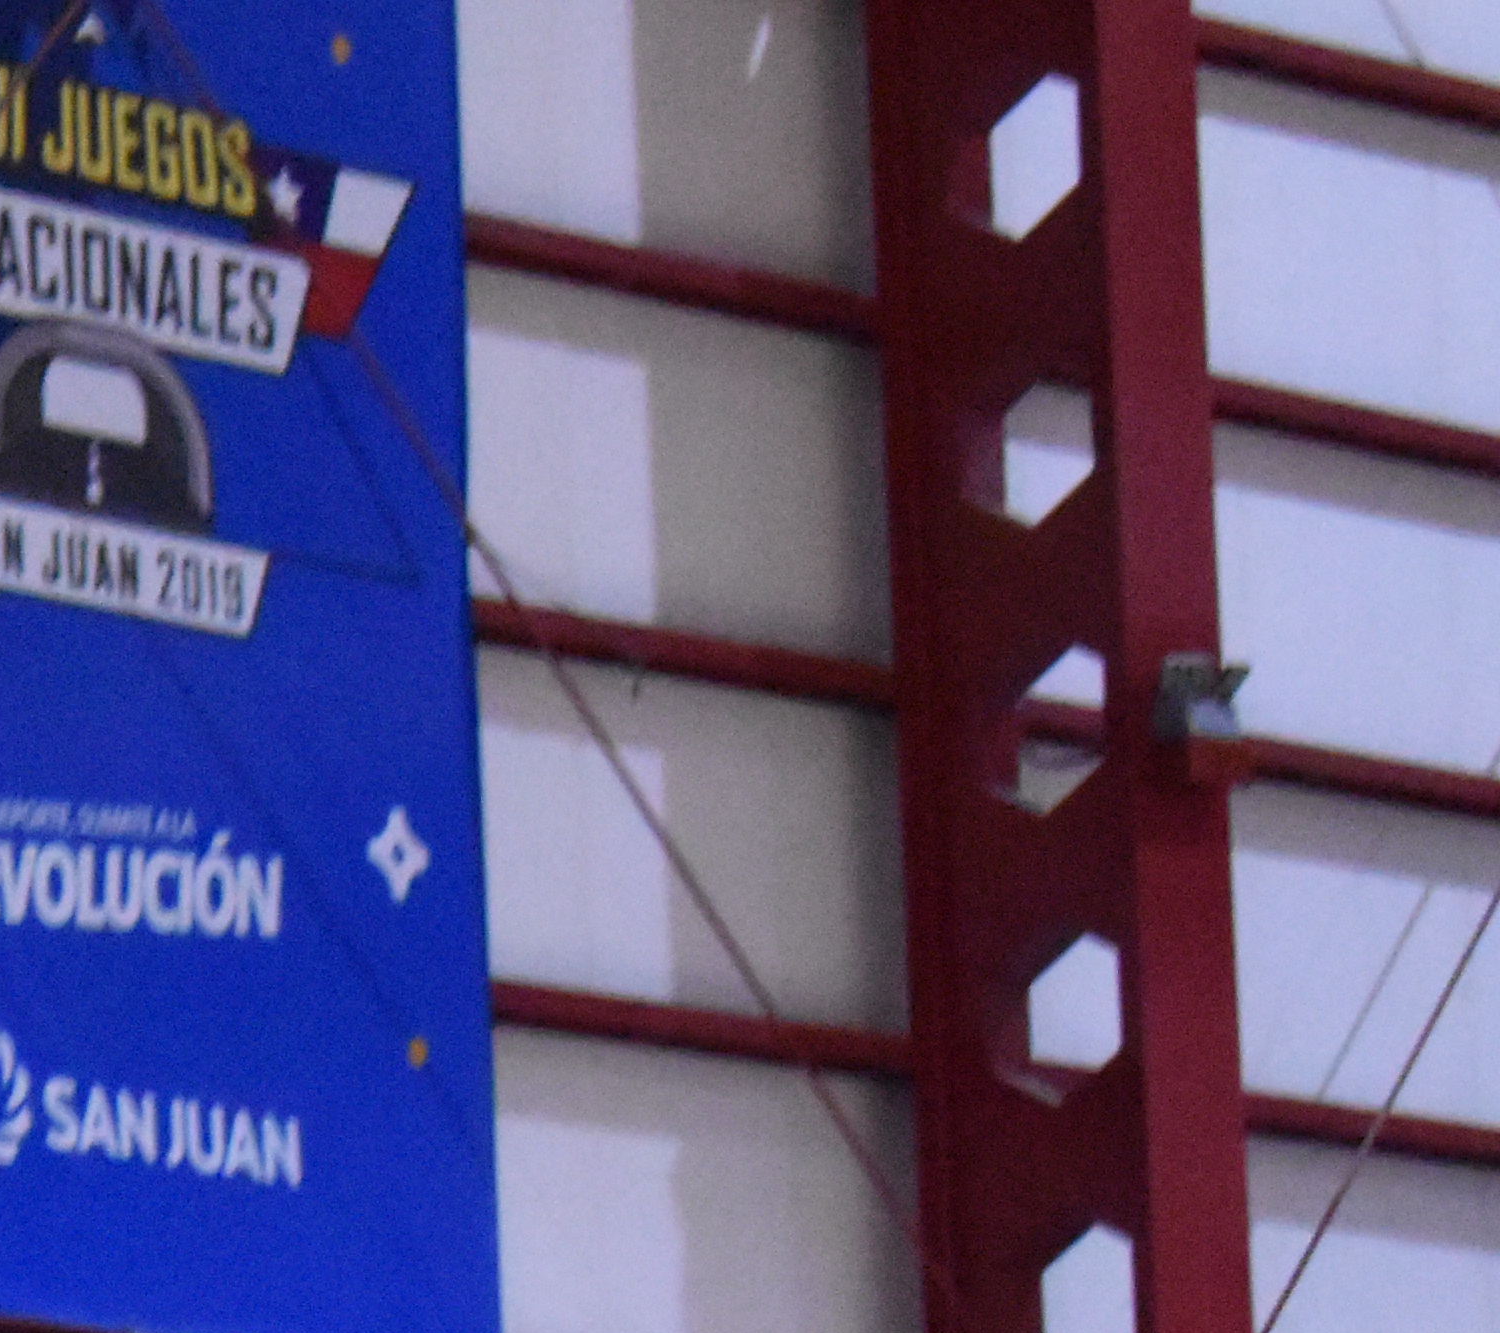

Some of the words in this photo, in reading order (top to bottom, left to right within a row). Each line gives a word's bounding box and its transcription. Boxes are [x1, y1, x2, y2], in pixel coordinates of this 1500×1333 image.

[41, 78, 258, 218] JUEGOS
[41, 524, 141, 599] JUAN
[156, 546, 250, 625] 2019
[42, 1073, 158, 1168] SAN
[164, 1096, 302, 1192] JUAN
